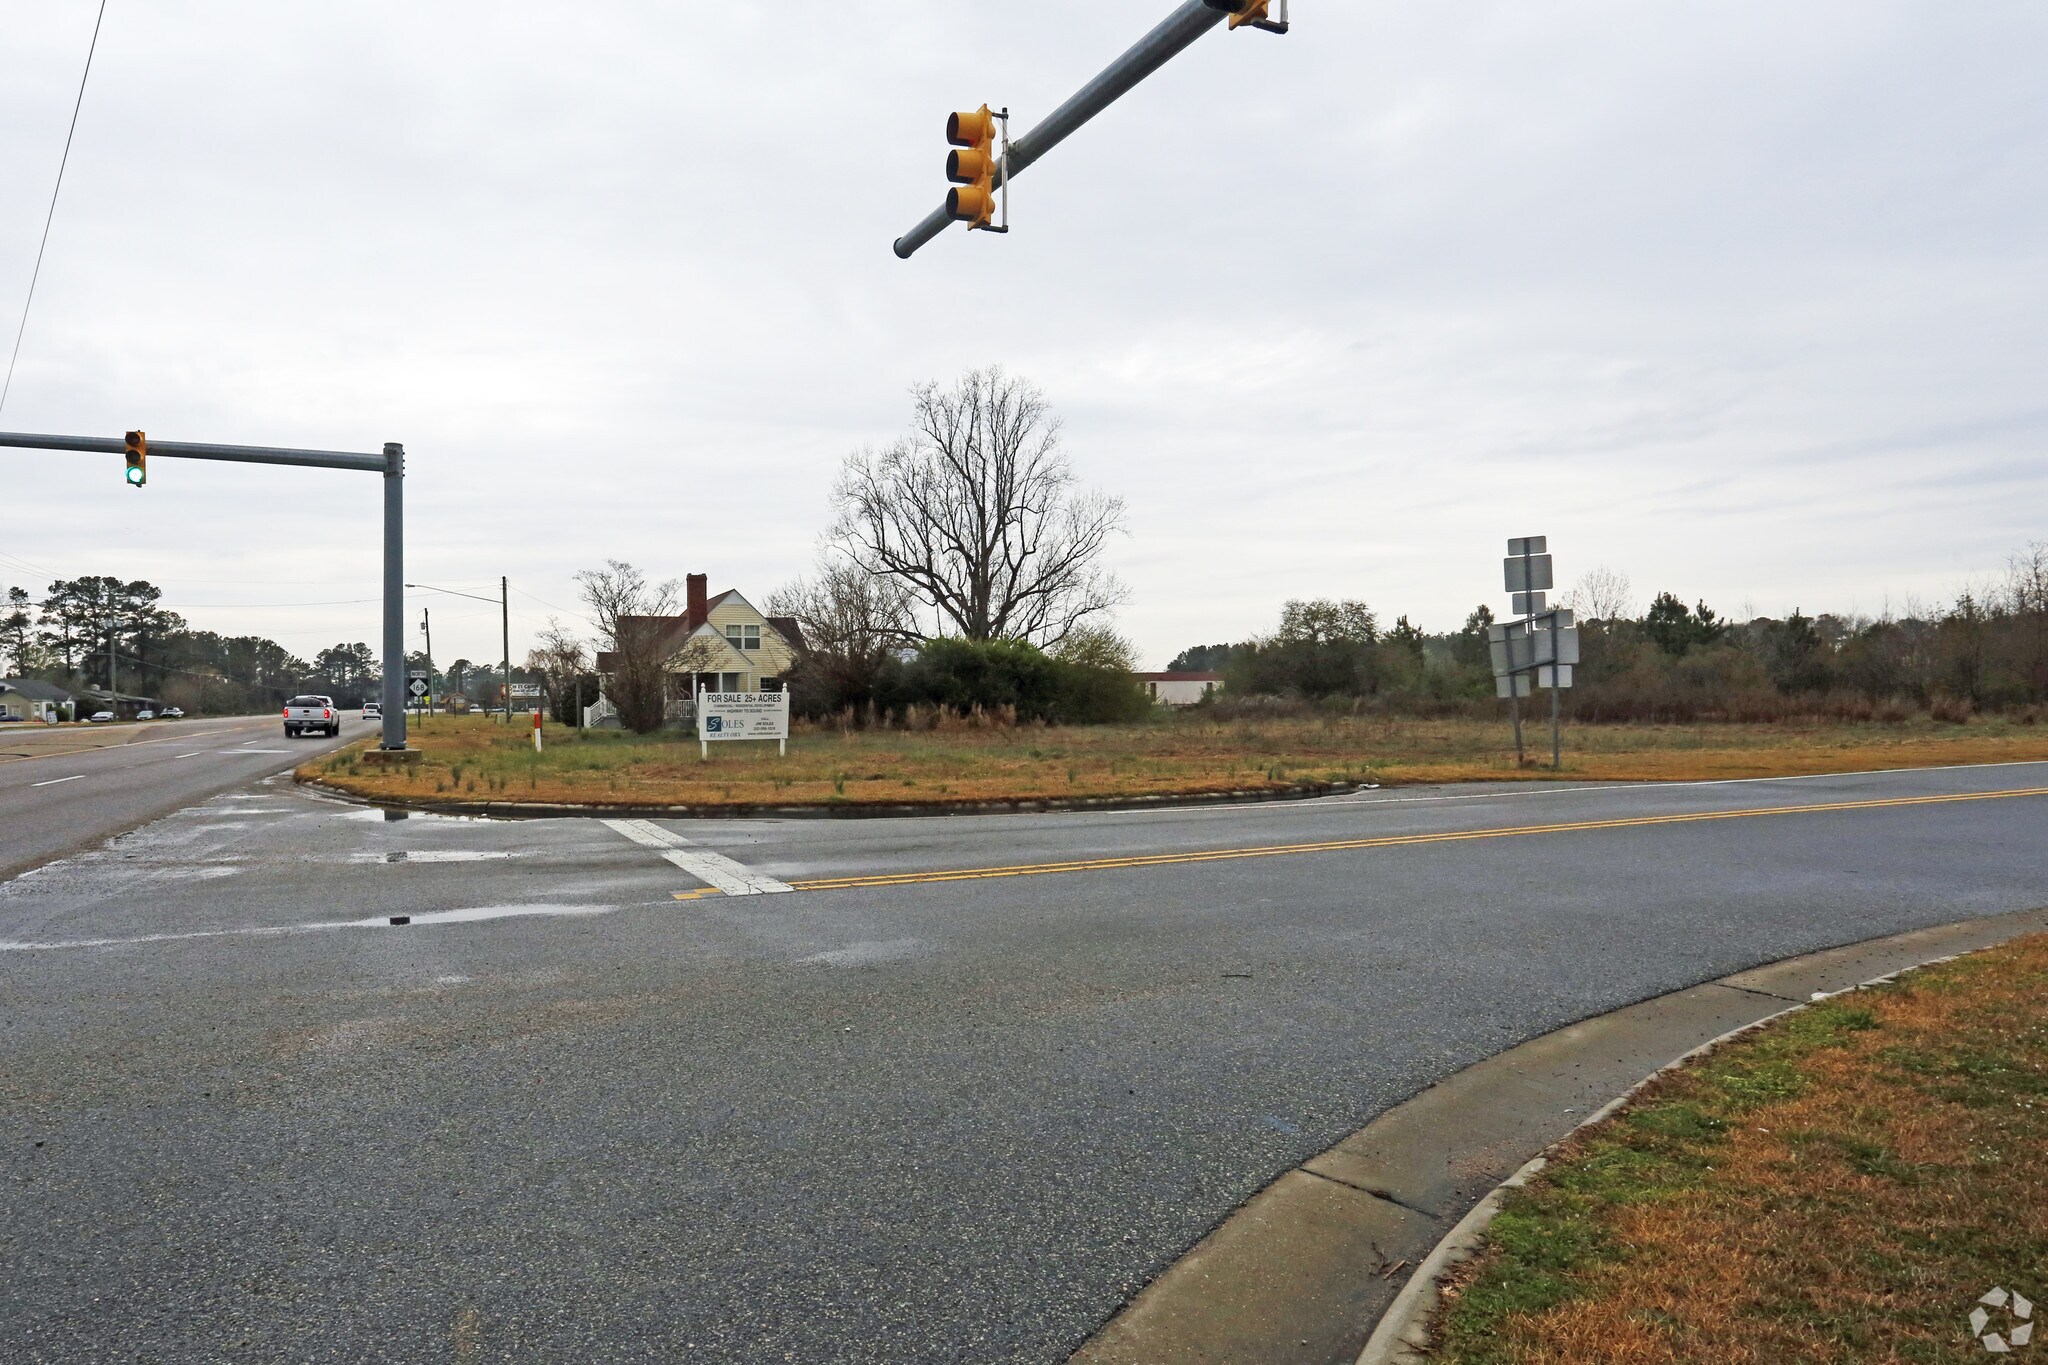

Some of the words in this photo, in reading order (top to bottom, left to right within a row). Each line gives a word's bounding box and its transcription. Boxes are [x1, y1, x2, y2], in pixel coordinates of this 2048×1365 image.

[707, 694, 722, 703] FOR
[723, 694, 741, 703] SALE
[744, 694, 757, 703] 25+
[758, 694, 782, 703] ACRES
